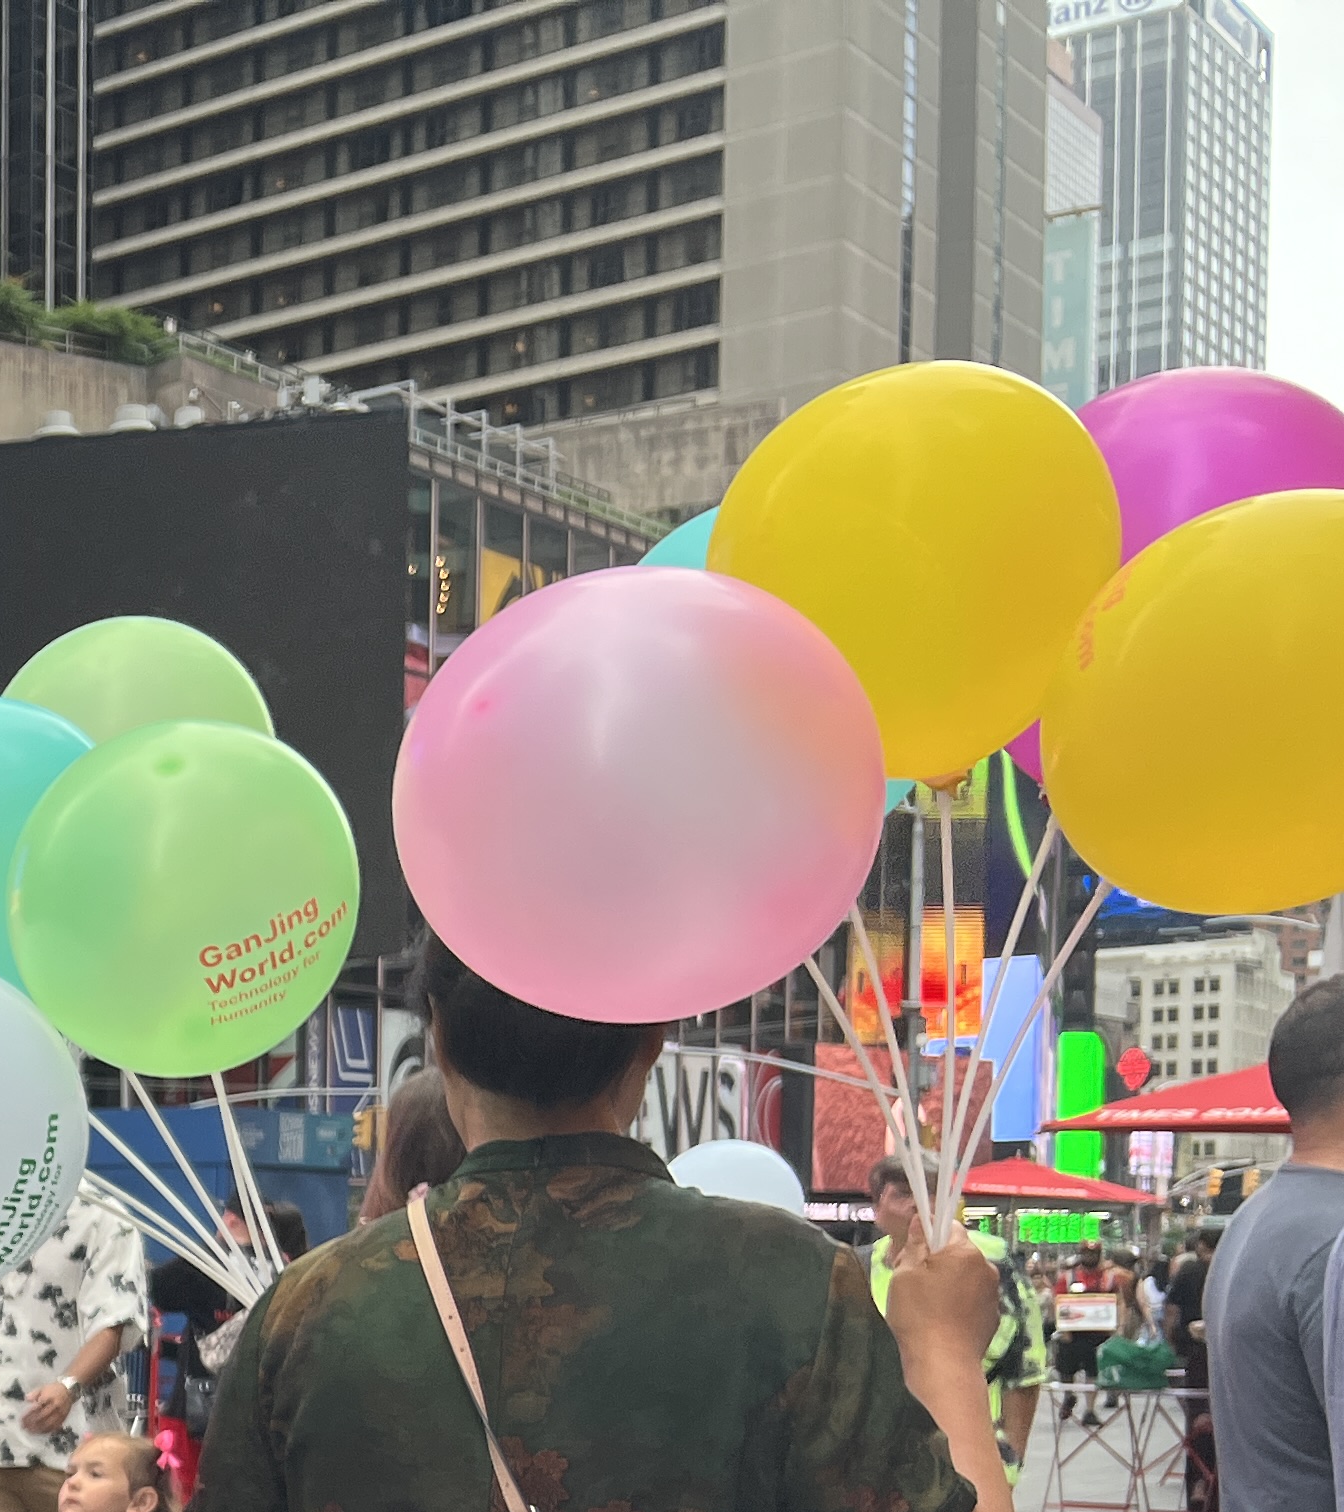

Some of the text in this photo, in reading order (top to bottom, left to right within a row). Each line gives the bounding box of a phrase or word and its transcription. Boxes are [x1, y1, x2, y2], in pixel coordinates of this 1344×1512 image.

[199, 897, 319, 968] GanJing
[204, 901, 348, 994] World.com
[208, 951, 321, 1012] Technology for
[210, 989, 288, 1027] Humanity
[1096, 1107, 1199, 1122] TIMES
